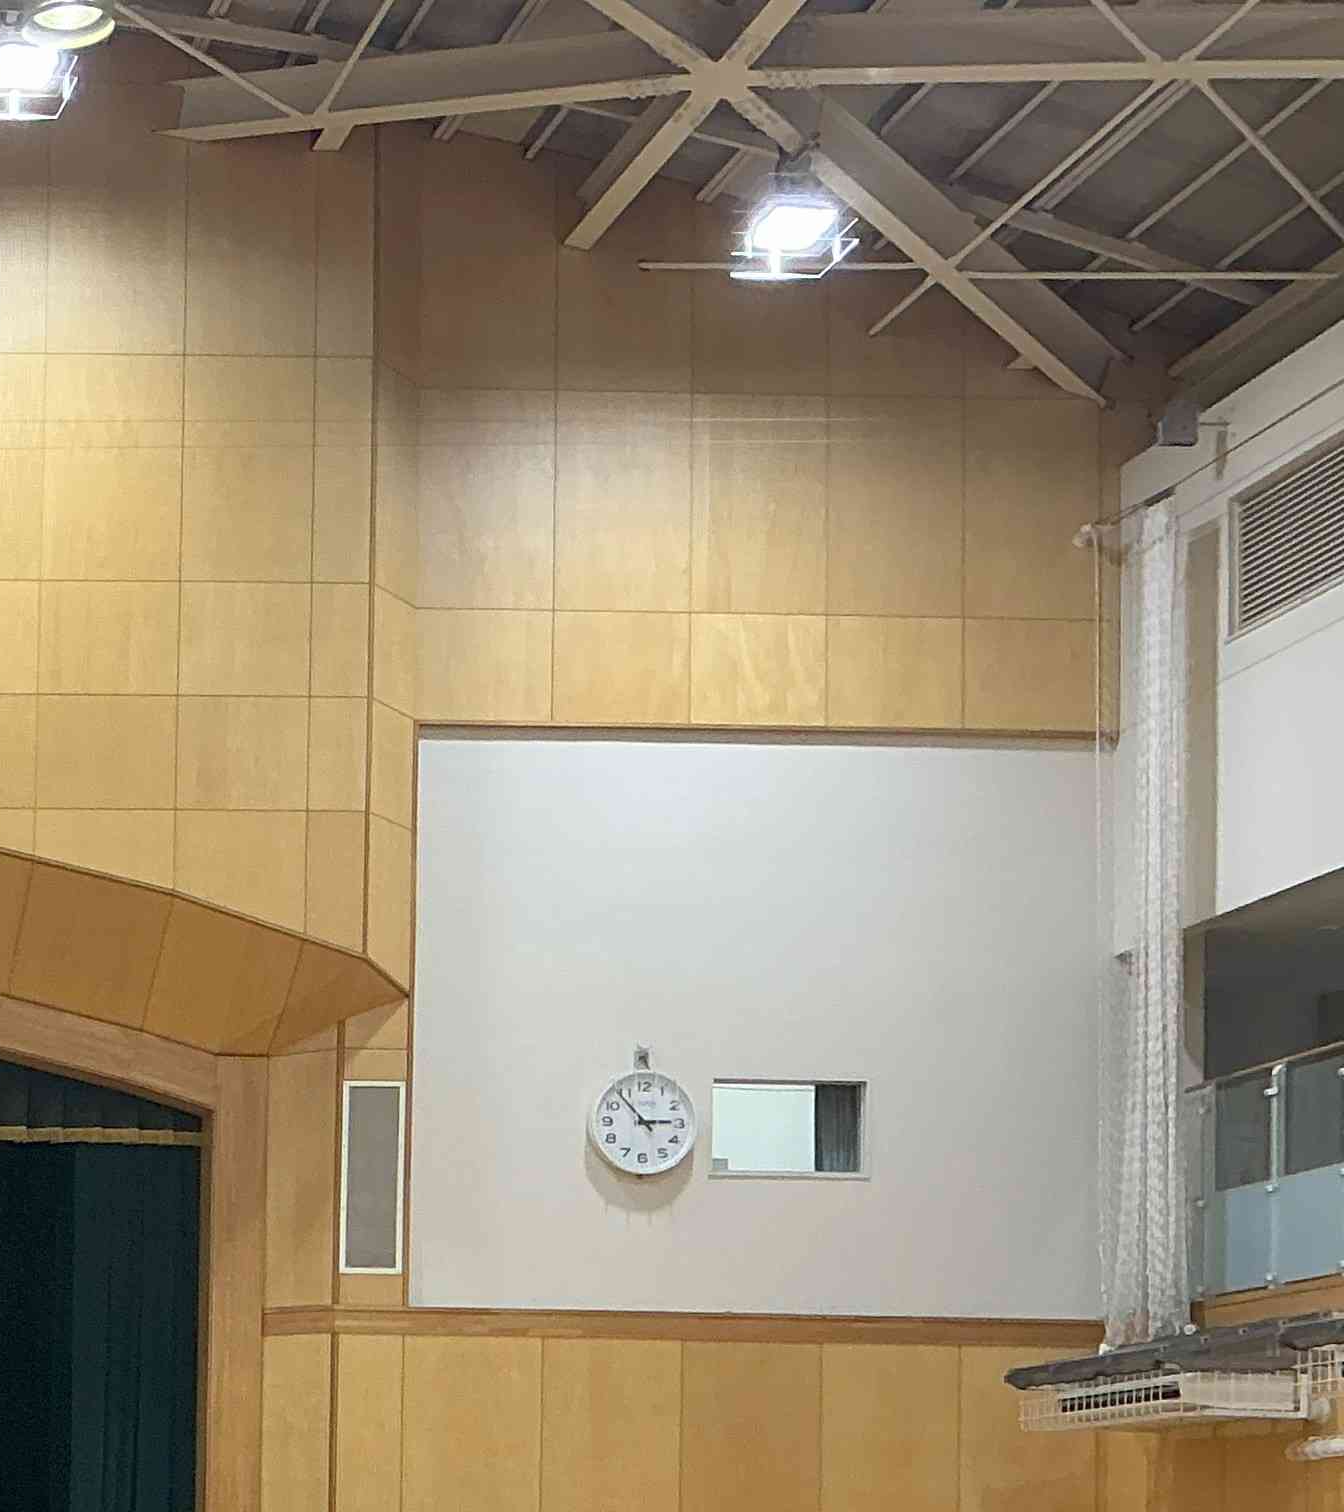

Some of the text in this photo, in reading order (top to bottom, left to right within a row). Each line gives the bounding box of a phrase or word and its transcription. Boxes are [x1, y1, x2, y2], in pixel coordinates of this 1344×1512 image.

[637, 1080, 652, 1093] 12
[606, 1100, 620, 1111] 10
[669, 1101, 680, 1111] 2
[601, 1115, 614, 1127] 9
[673, 1117, 685, 1129] 3
[605, 1132, 617, 1144] 8
[667, 1134, 680, 1144] 4
[619, 1147, 632, 1158] 7
[637, 1152, 649, 1164] 6
[656, 1147, 669, 1159] 5
